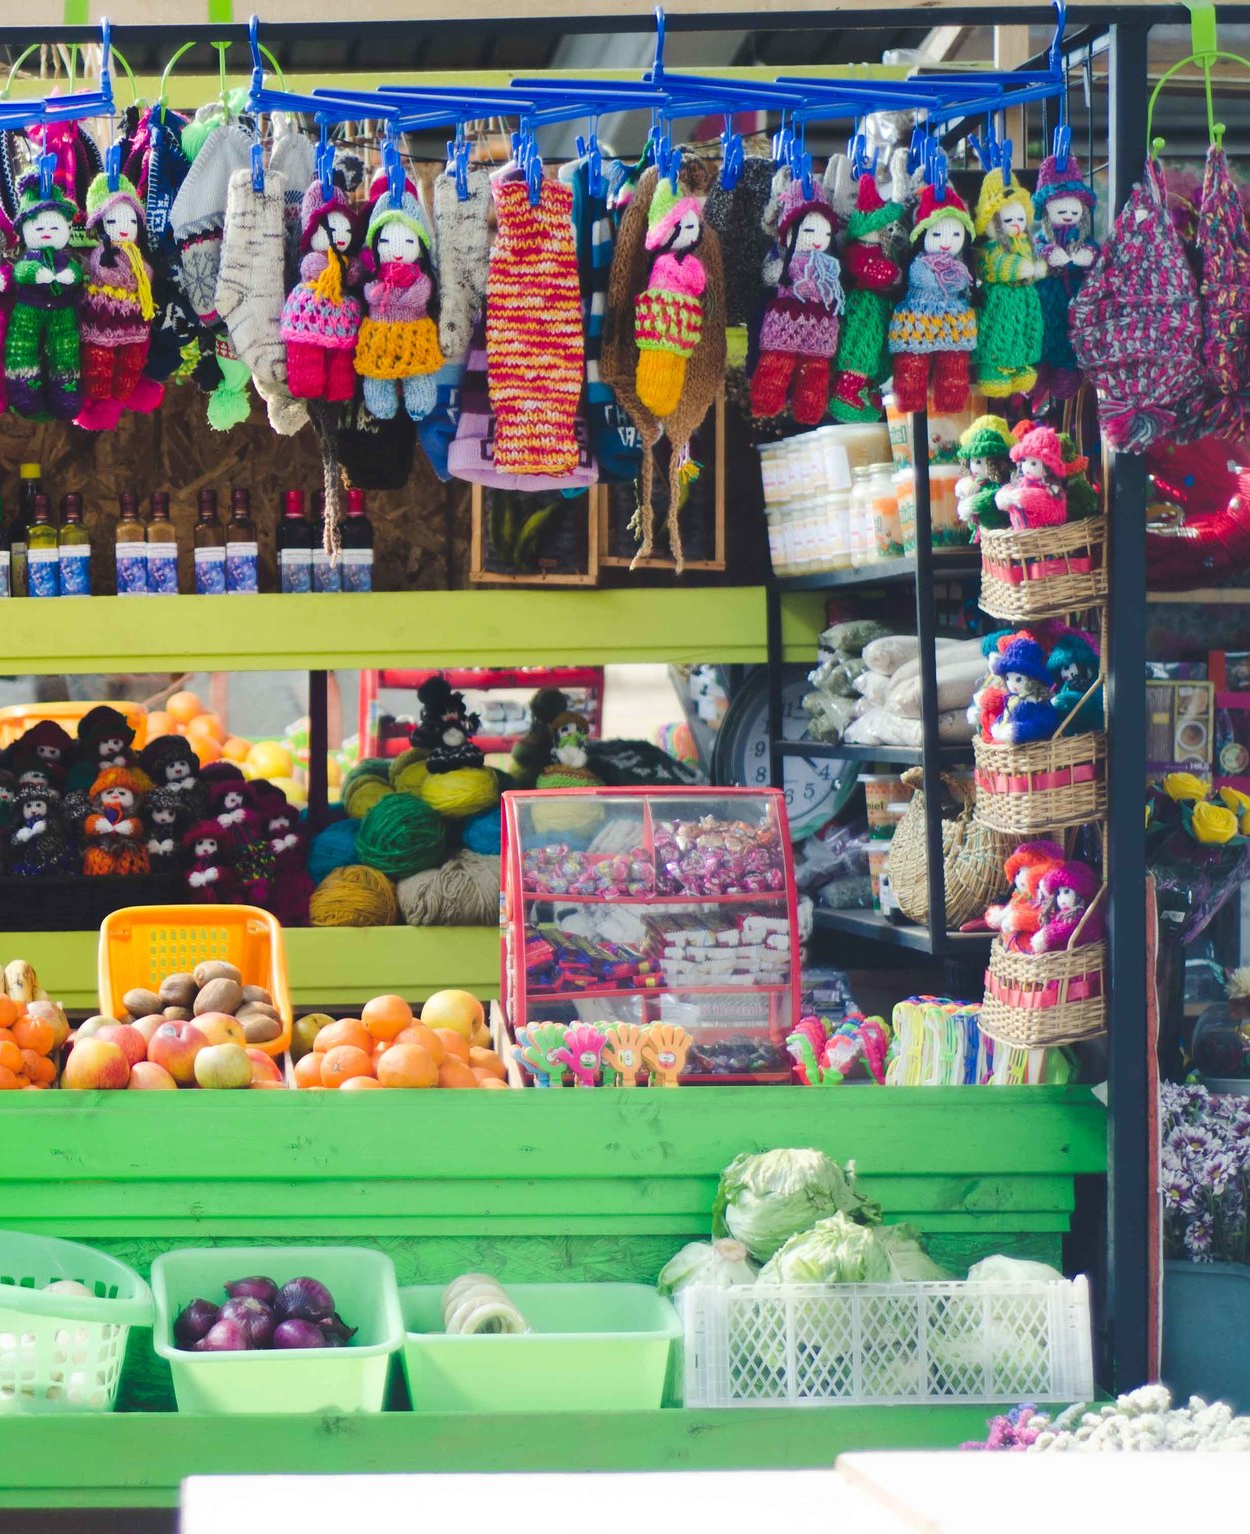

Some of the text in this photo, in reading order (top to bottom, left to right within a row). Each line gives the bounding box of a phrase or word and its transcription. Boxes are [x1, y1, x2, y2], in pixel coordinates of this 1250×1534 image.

[754, 740, 766, 758] 9
[755, 766, 767, 783] 8
[819, 763, 831, 780] 4
[803, 782, 816, 799] 5
